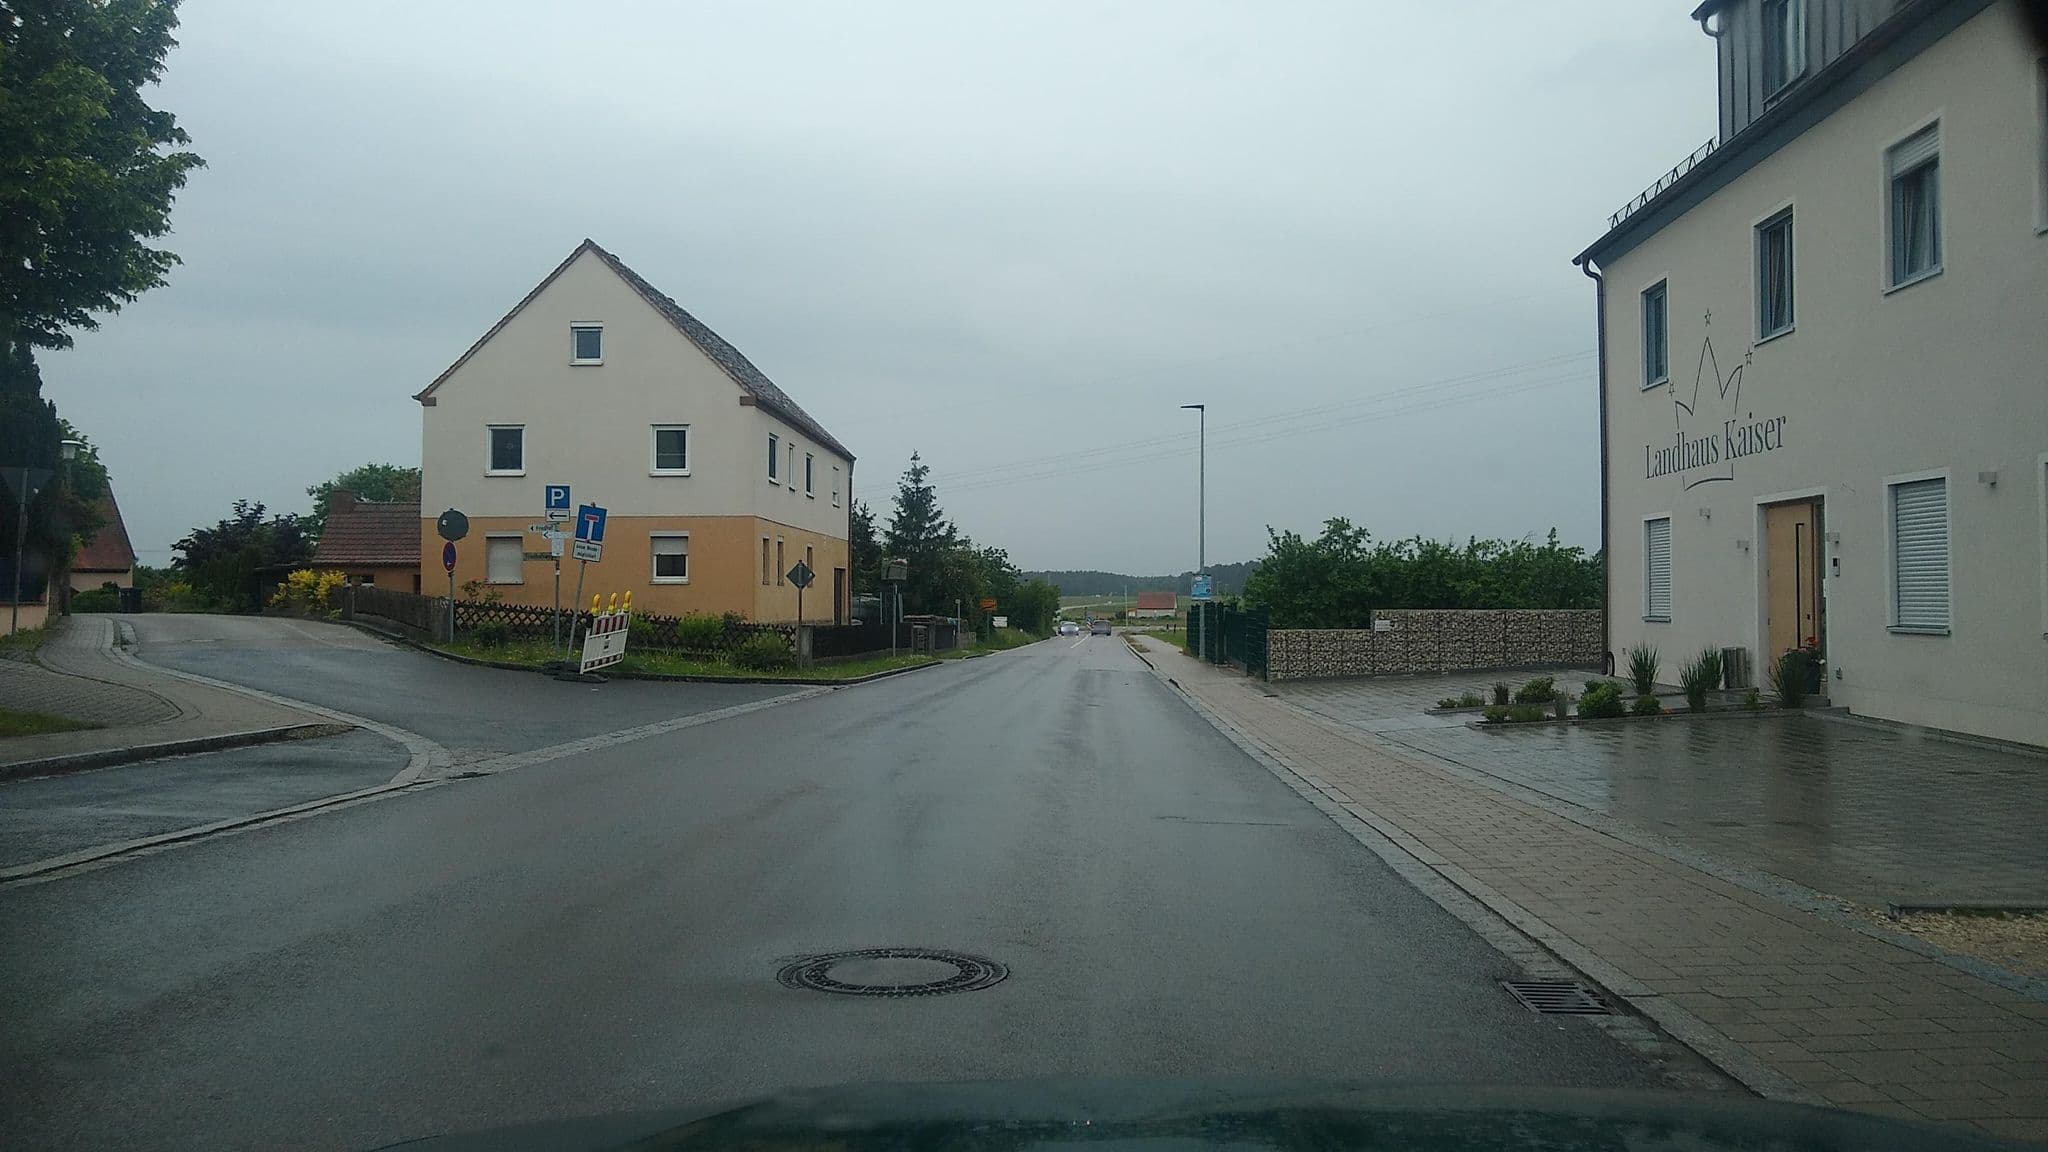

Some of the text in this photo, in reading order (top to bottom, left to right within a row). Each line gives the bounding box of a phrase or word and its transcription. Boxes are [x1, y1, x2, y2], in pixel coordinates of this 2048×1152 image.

[1645, 412, 1786, 479] Landhaus Kaiser
[551, 488, 565, 506] P
